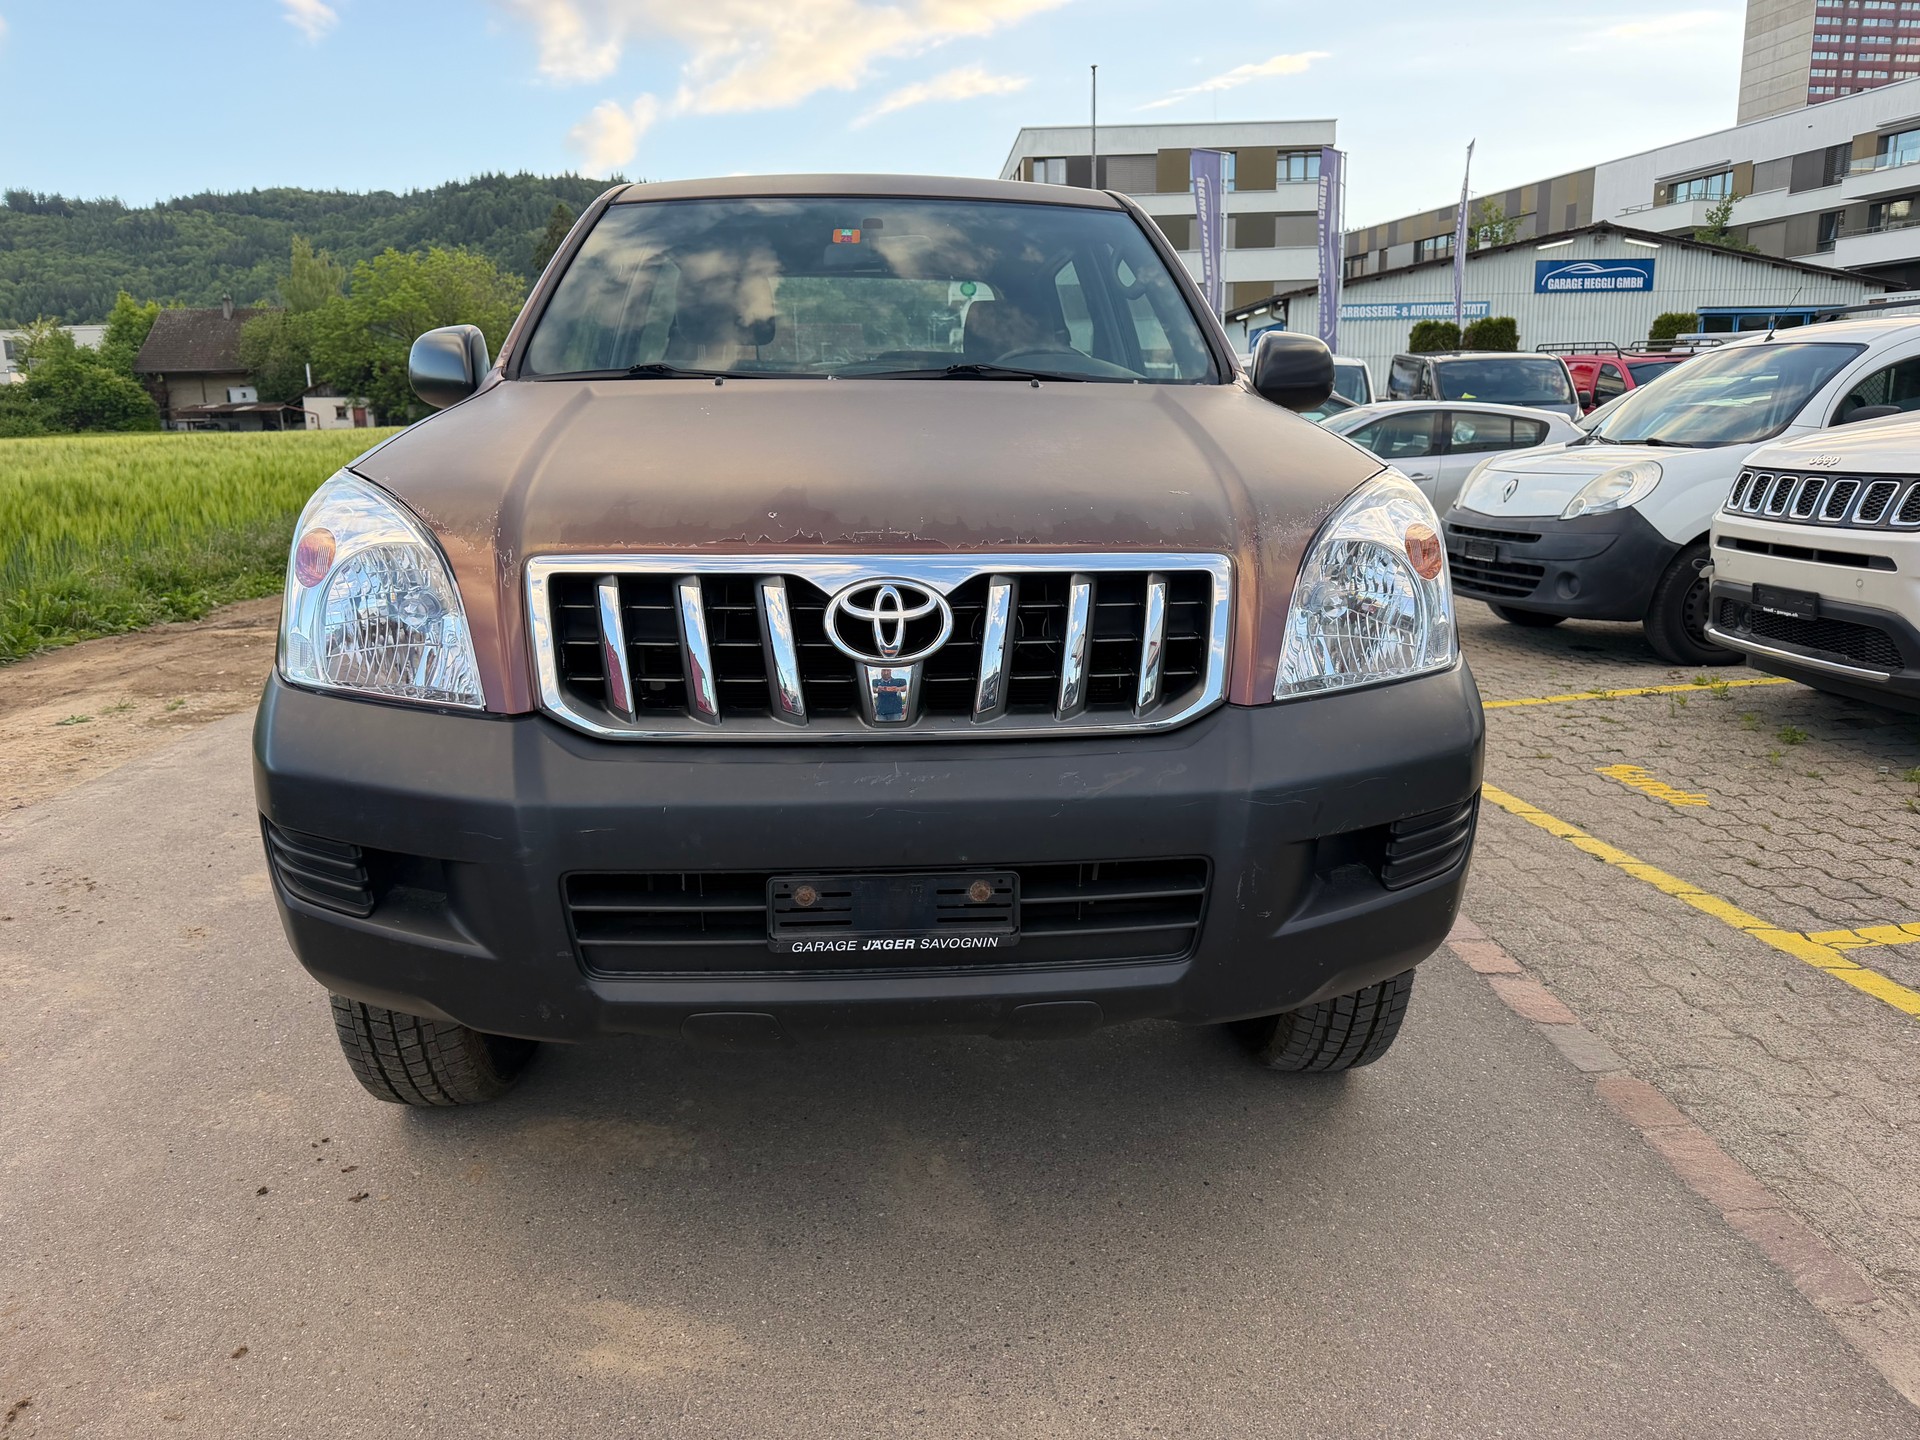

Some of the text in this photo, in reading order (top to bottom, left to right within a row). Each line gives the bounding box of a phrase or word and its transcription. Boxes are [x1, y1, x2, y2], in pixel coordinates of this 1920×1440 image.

[1547, 277, 1644, 290] GARAGE HEGGLI GMBH
[1401, 306, 1409, 317] &
[1410, 304, 1488, 316] AUTOWERSTATT
[1809, 454, 1841, 468] Jeep
[791, 937, 999, 953] GARAGE JÄGER SAVOGNIN
